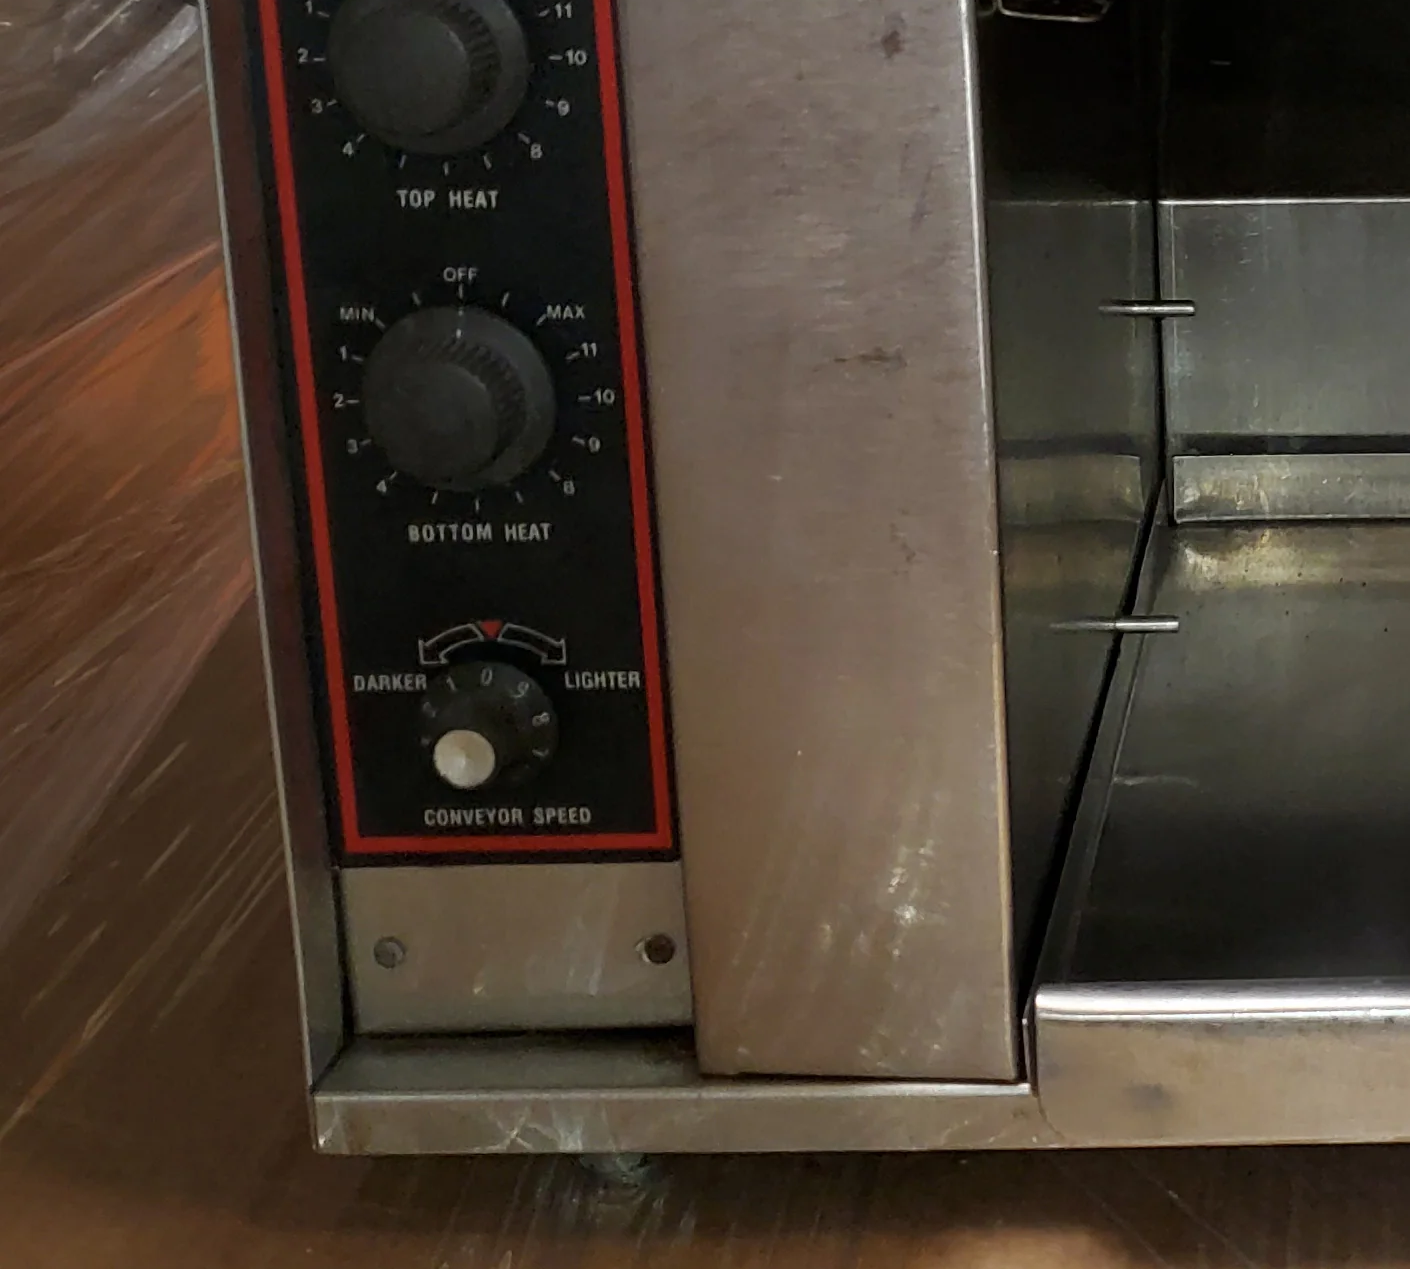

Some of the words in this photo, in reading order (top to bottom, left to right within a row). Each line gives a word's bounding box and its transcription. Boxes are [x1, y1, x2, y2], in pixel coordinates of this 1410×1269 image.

[305, 0, 313, 14] 1
[555, 3, 573, 18] 11
[297, 48, 310, 63] 2
[565, 49, 587, 66] 10
[311, 99, 323, 114] 3
[342, 141, 354, 156] 4
[396, 189, 435, 209] TOP
[449, 189, 499, 209] HEAT
[443, 267, 478, 282] OFF
[339, 307, 375, 322] MIN
[546, 305, 585, 320] MAX
[339, 346, 348, 361] 1
[580, 342, 598, 357] 11
[333, 394, 344, 408] 2
[594, 389, 615, 405] 10
[408, 523, 493, 543] BOTTOM
[505, 522, 551, 541] HEAT
[353, 673, 427, 692] DARKER
[564, 671, 641, 690] LIGHTER
[424, 808, 523, 827] CONVEYOR
[534, 807, 592, 825] SPEED
